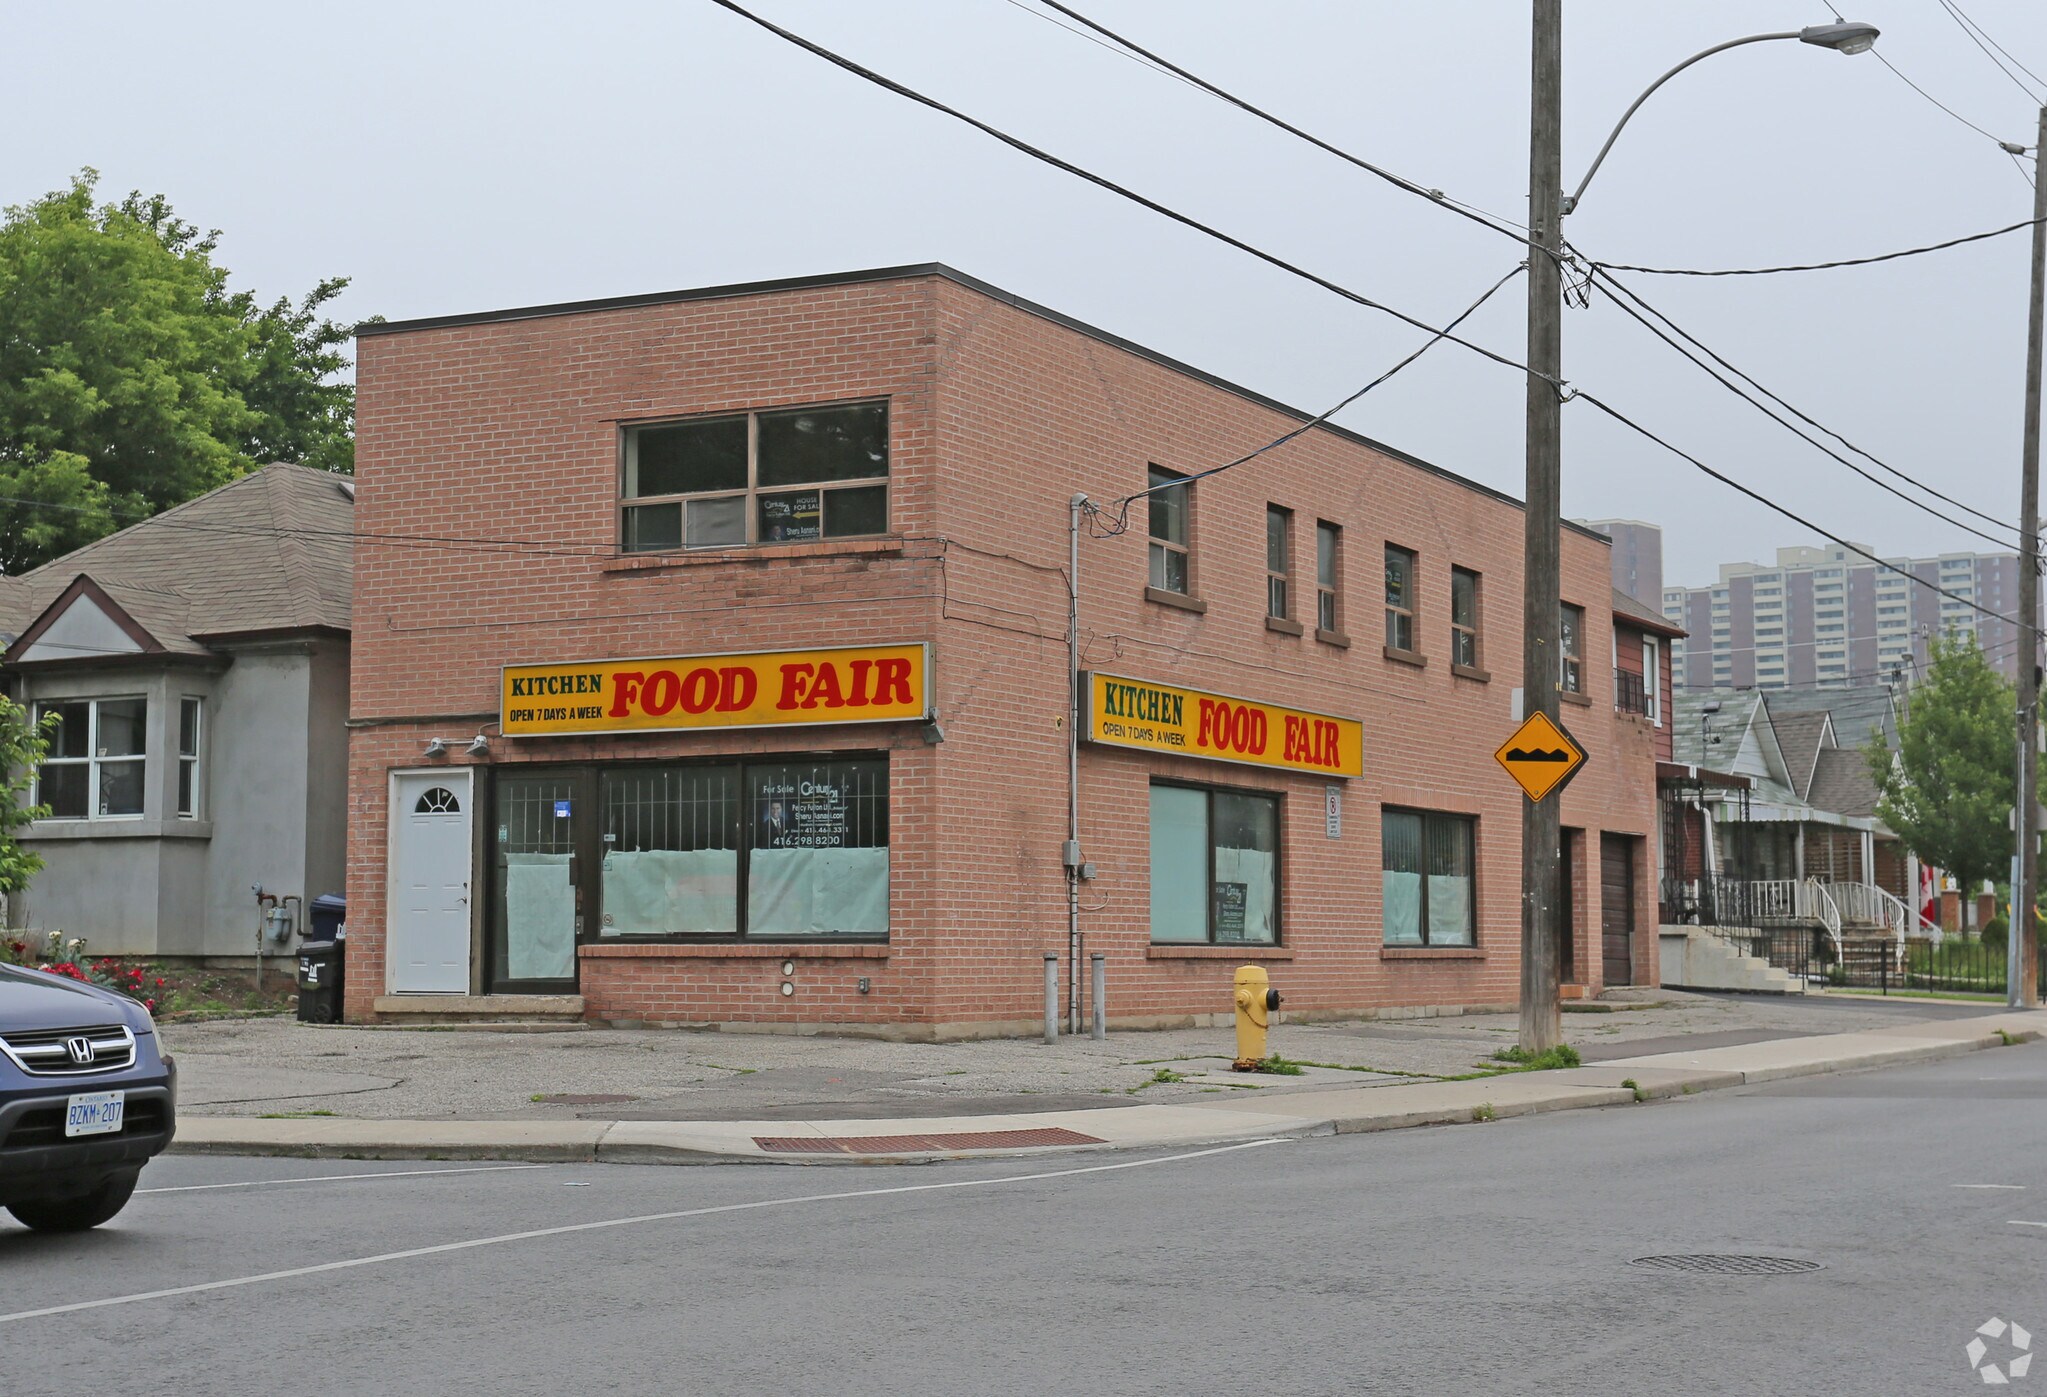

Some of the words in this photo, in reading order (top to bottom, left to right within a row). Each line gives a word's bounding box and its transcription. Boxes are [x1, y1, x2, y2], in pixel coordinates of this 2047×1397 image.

[511, 674, 603, 697] KITCHEN
[608, 666, 758, 718] FOOD
[776, 658, 914, 710] FAIR
[510, 709, 534, 722] OPEN
[537, 709, 543, 721] 7
[543, 707, 566, 721] DAYS
[569, 707, 576, 720] A
[577, 706, 602, 719] WEEK
[1104, 682, 1184, 727] KITCHEN
[1103, 721, 1126, 738] OPEN
[1128, 726, 1133, 738] 7
[1133, 727, 1154, 742] DAYS
[1157, 730, 1163, 743] A
[1163, 731, 1186, 746] WEEK
[1197, 698, 1267, 756] FOOD
[1283, 715, 1340, 768] FAIR
[763, 785, 775, 794] For
[777, 785, 794, 794] Sale
[801, 781, 832, 796] Century
[773, 836, 840, 846] 416.2988200
[70, 1104, 96, 1125] BZKM
[102, 1101, 122, 1122] 207
